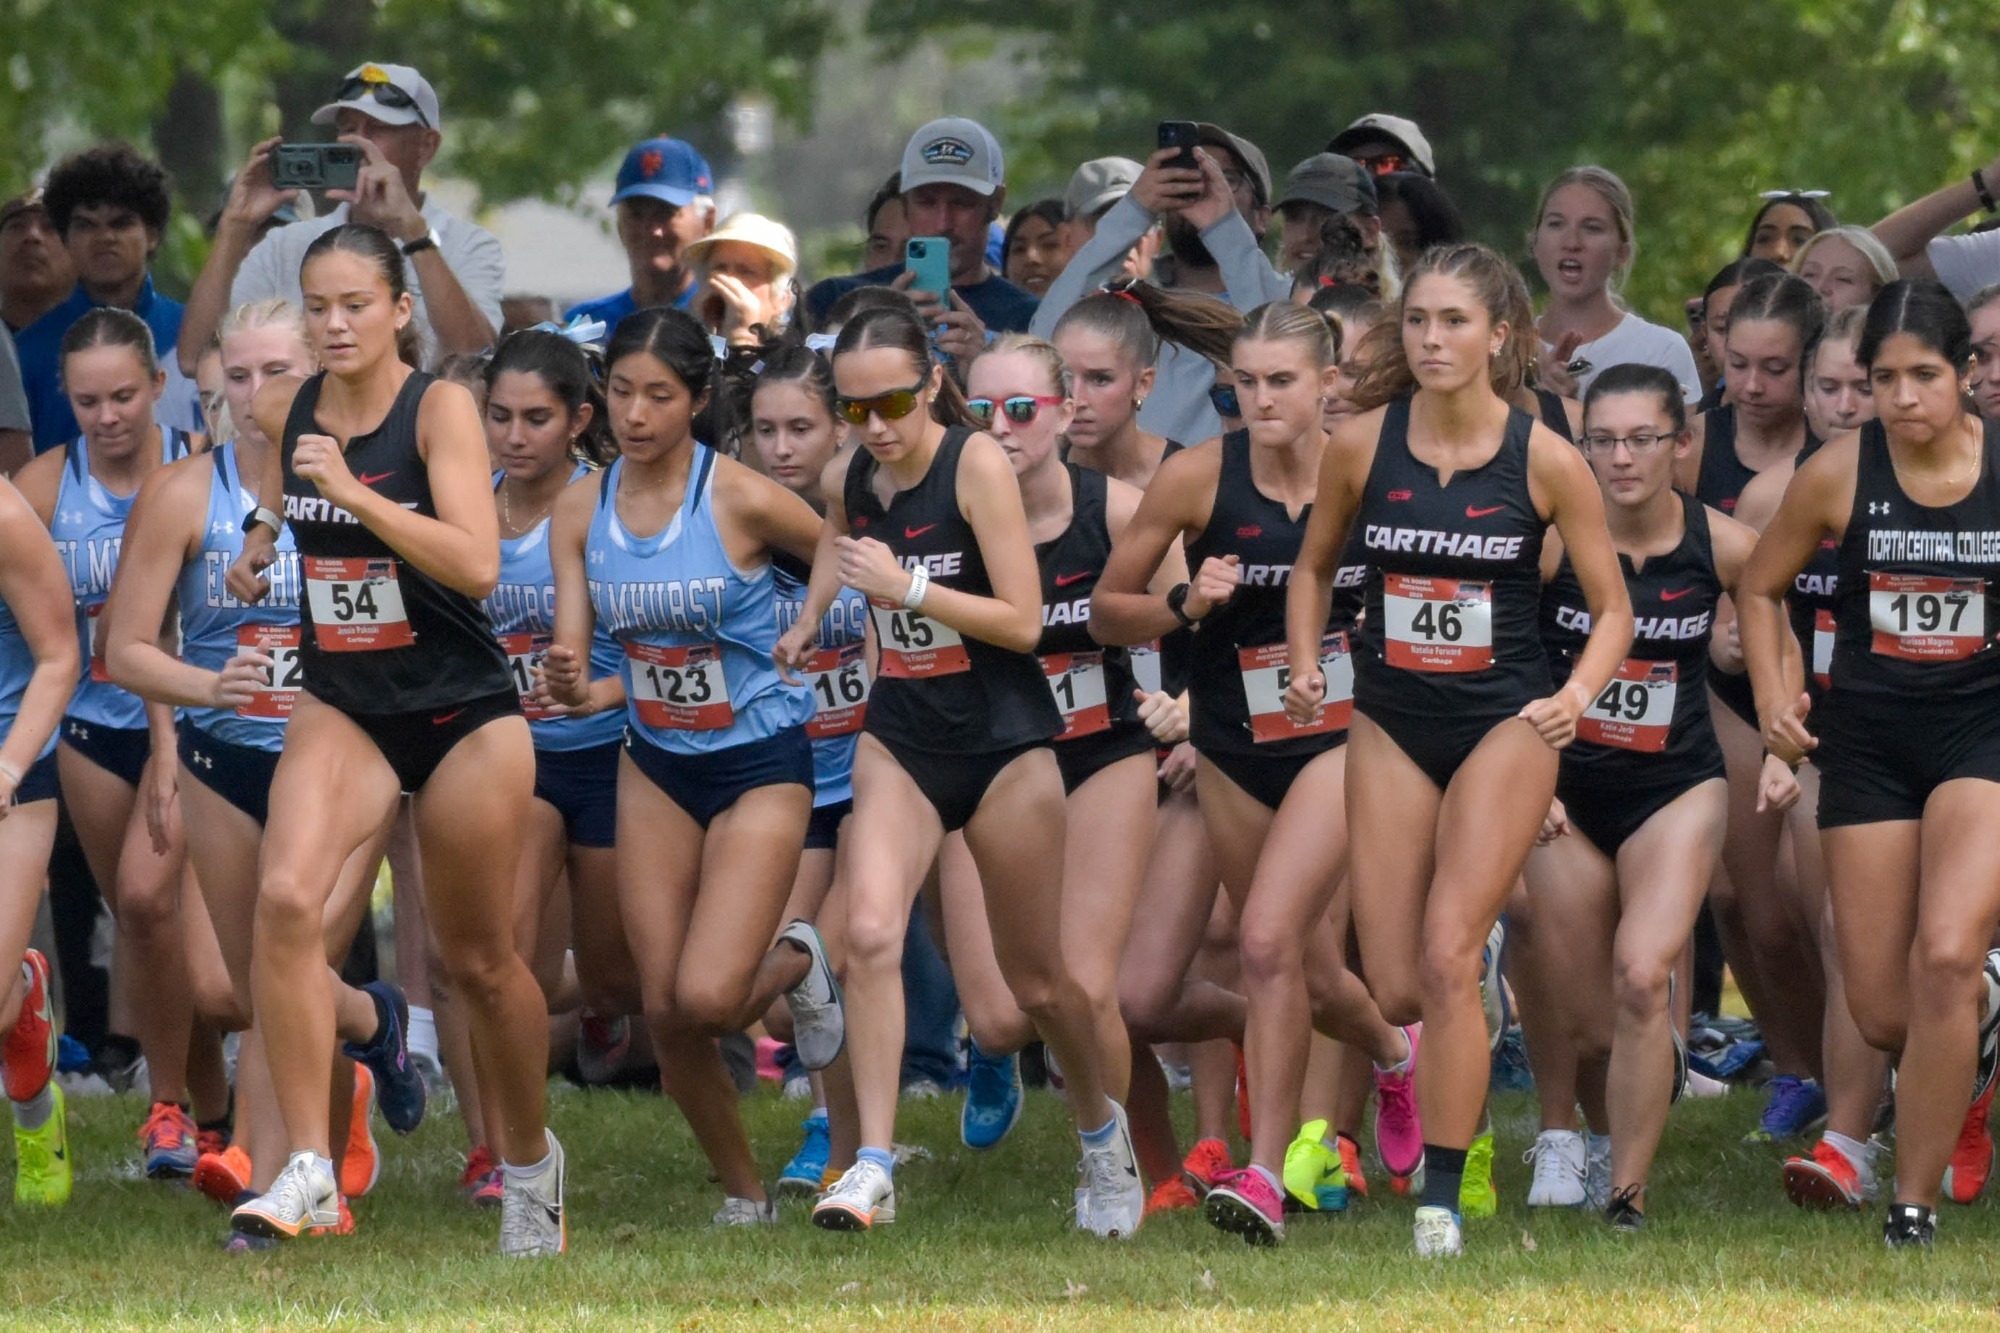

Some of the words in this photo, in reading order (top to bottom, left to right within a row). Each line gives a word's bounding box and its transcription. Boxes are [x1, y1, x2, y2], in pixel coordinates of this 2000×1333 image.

[1365, 524, 1524, 560] CARTHAGE
[1868, 530, 1905, 561] NORTH
[1907, 530, 1955, 562] CENTRAL
[1957, 531, 2000, 563] COLLEGE
[331, 583, 379, 621] 54
[1891, 594, 1969, 632] 197
[891, 612, 934, 648] 45
[1411, 602, 1462, 642] 46
[1556, 605, 1710, 640] CAHAGE
[646, 665, 712, 703] 123
[1596, 681, 1649, 721] 49
